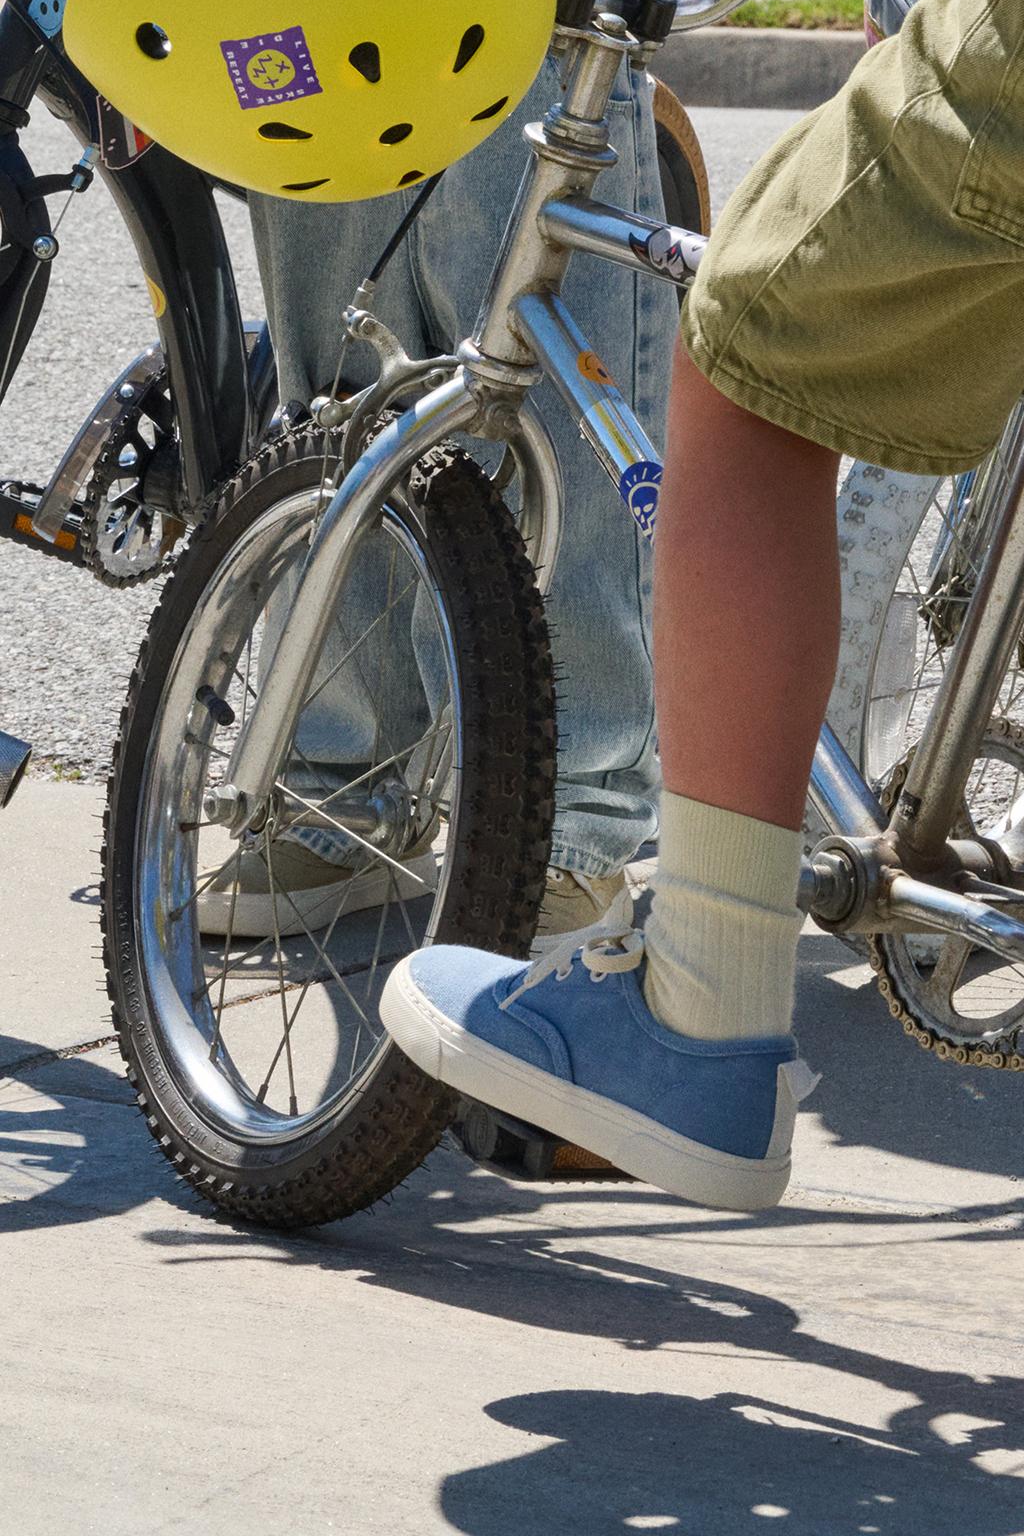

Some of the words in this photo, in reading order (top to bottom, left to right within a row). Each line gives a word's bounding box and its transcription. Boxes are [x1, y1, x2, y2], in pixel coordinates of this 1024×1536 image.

[226, 51, 249, 100] REPEAT
[294, 40, 315, 84] LIVE
[256, 88, 305, 105] SKATE
